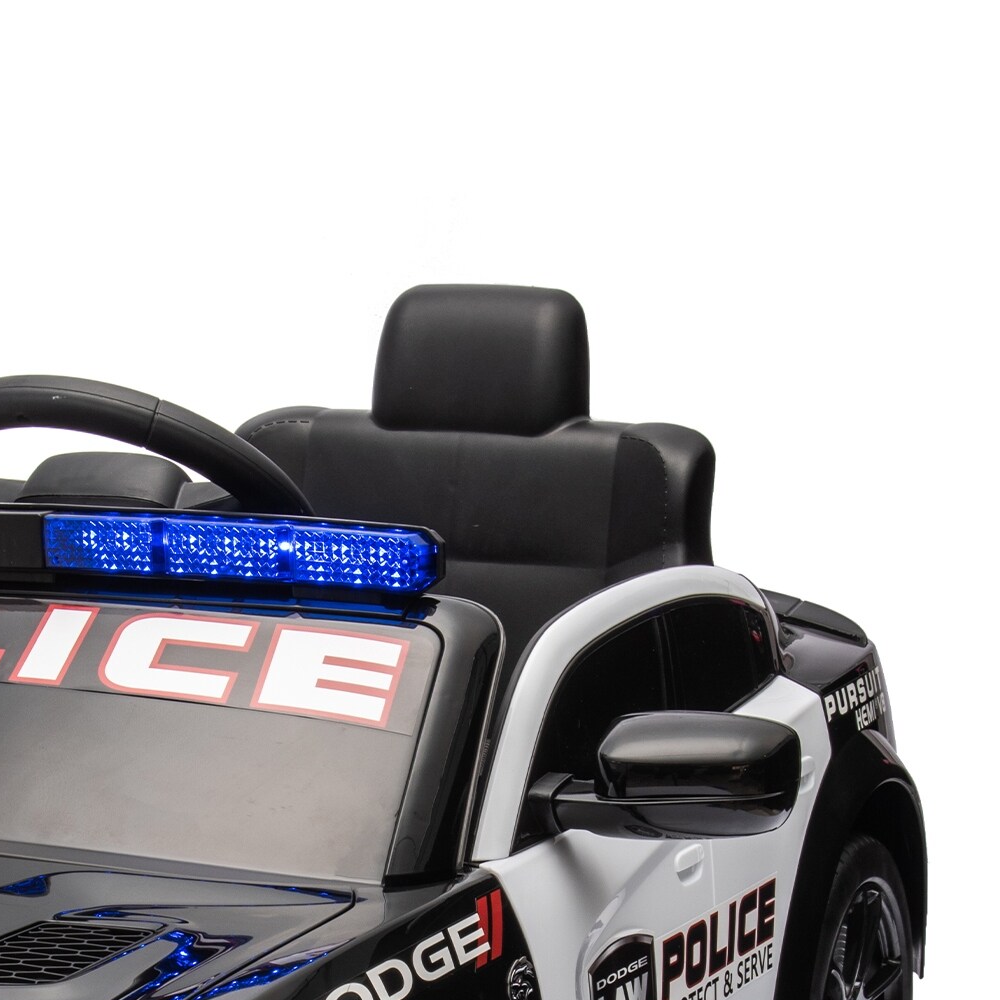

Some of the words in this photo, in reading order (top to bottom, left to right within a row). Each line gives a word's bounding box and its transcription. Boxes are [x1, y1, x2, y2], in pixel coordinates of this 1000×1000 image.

[824, 666, 882, 722] PURSUIT
[596, 955, 648, 991] DODGE
[723, 970, 733, 997] &
[736, 943, 773, 989] SERVE
